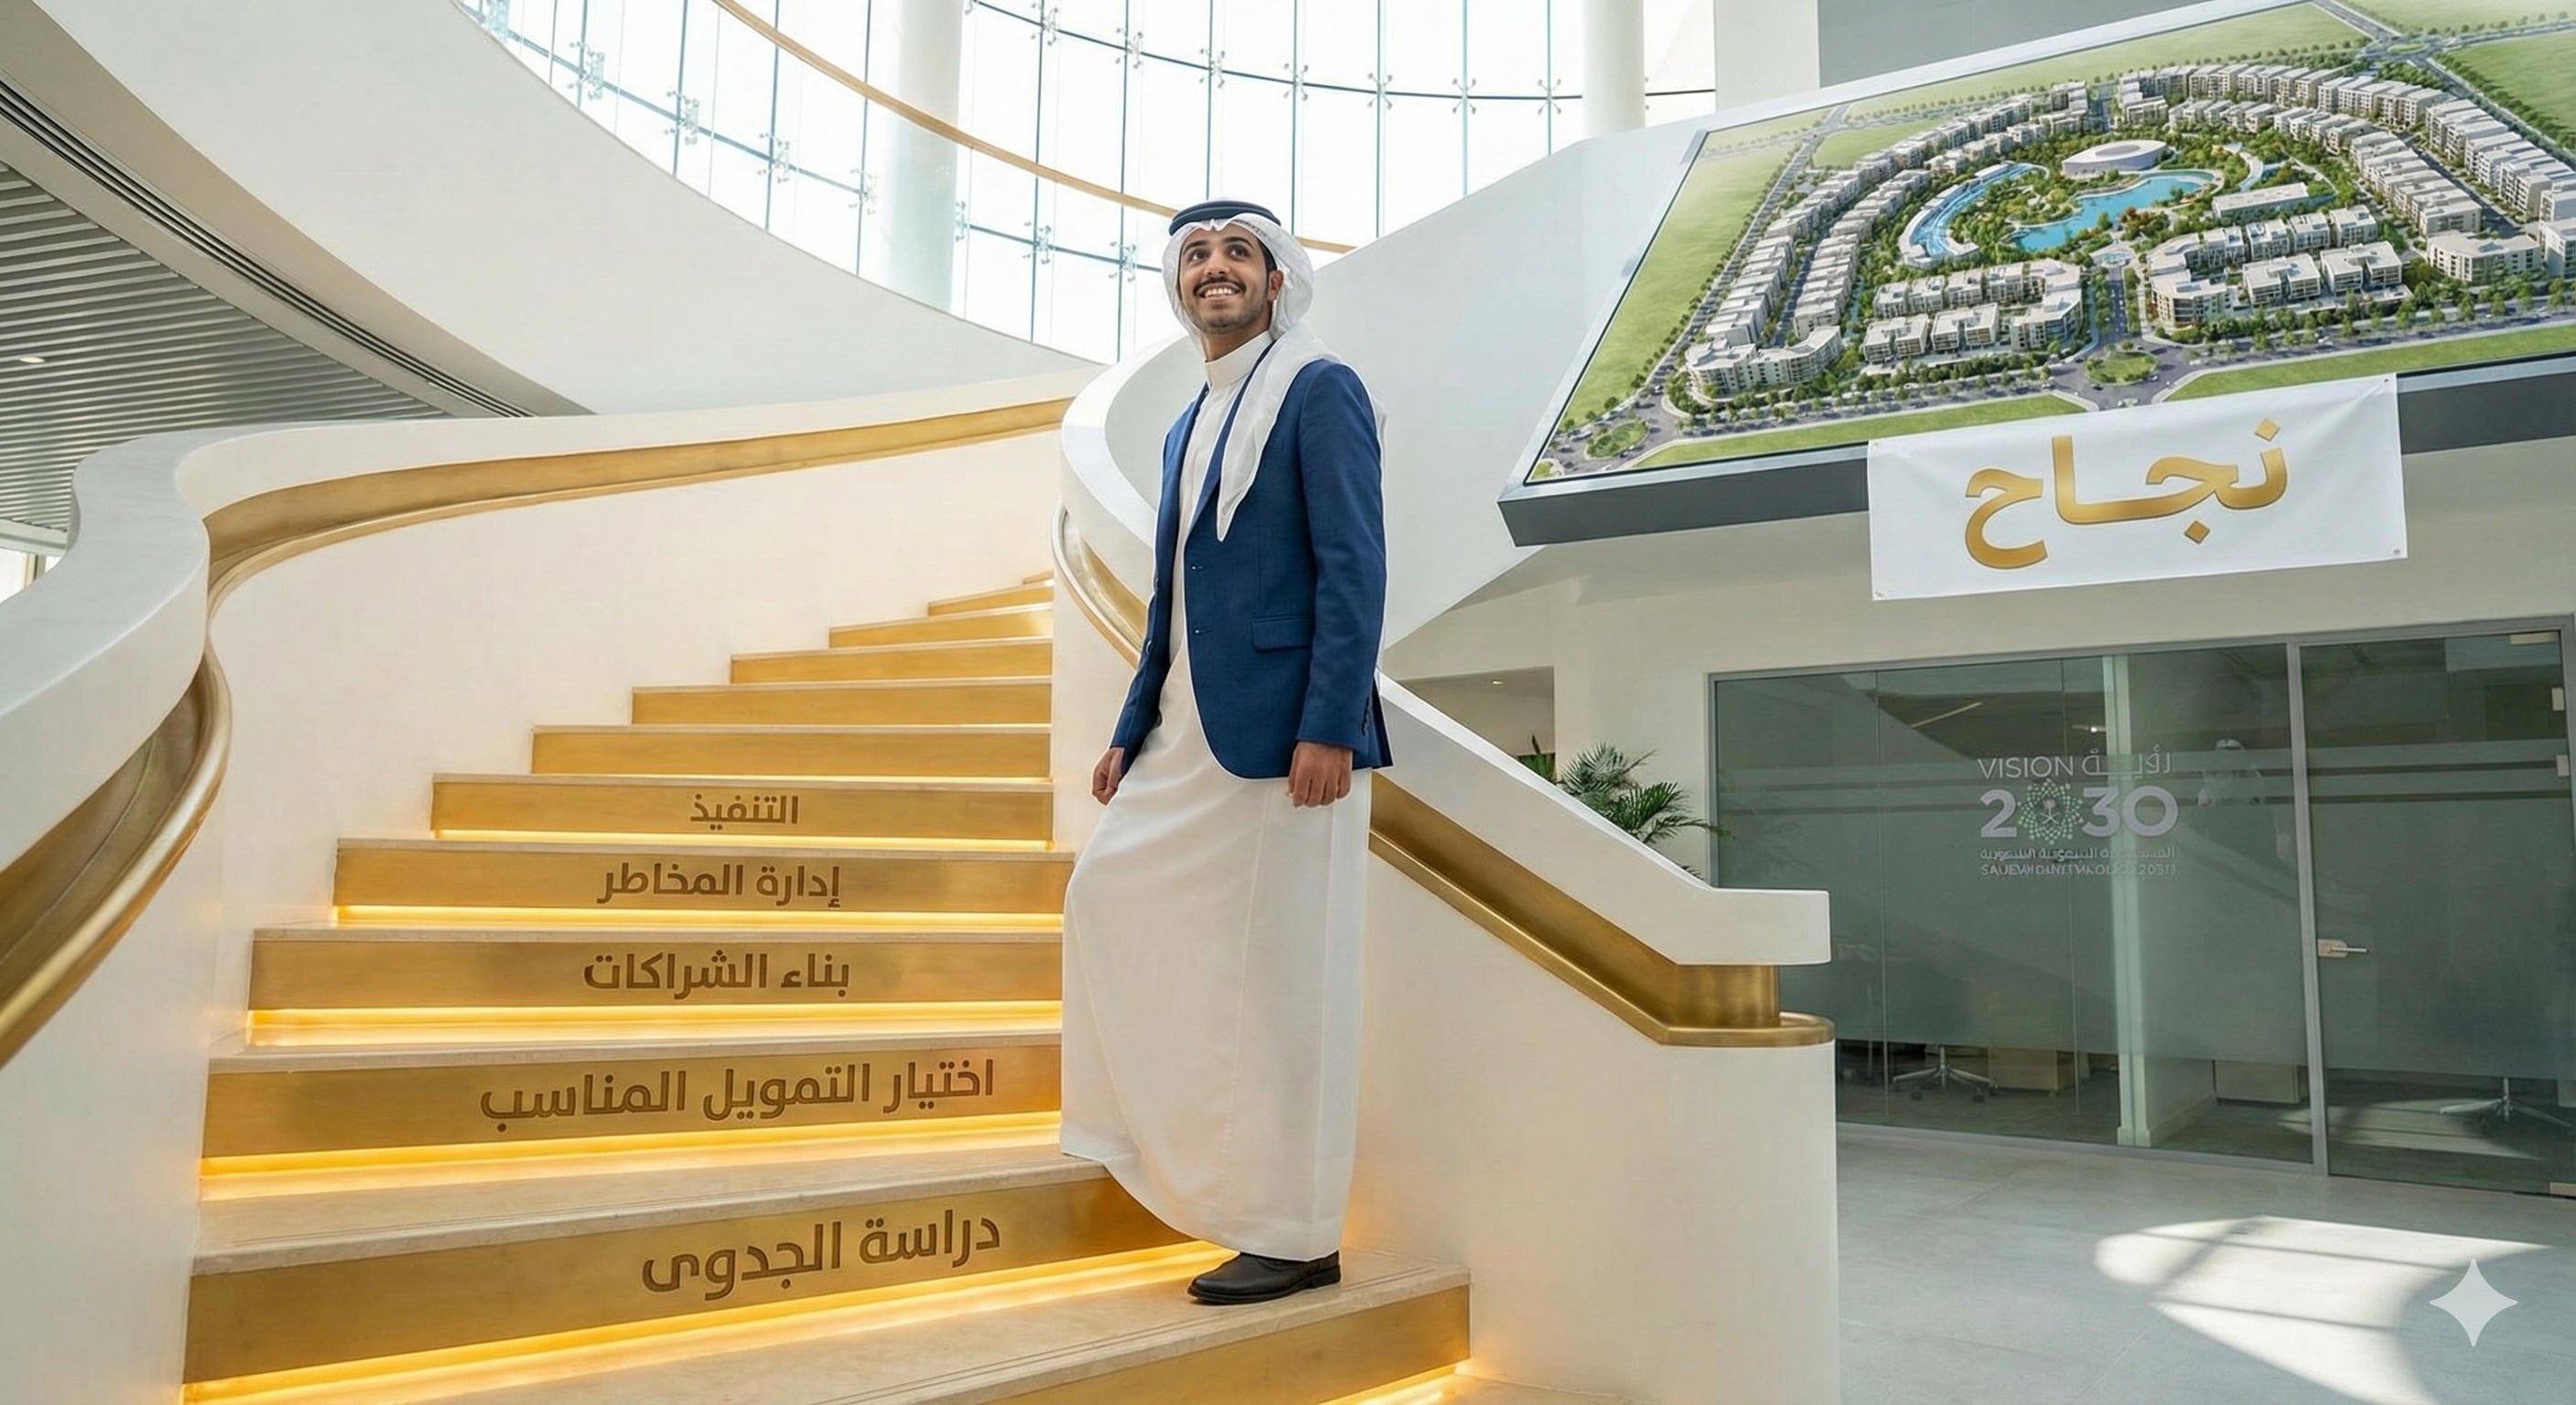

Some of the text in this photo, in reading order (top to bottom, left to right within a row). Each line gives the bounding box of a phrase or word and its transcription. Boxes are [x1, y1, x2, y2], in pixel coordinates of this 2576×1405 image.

[1964, 417, 2290, 571] نجاح
[1977, 755, 2075, 779] VISION
[690, 793, 799, 831] التنفيذ
[596, 862, 841, 908] إدارة المخاطر
[584, 949, 850, 1001] بناء الشراكات
[480, 1058, 993, 1133] اختيار التمويل المناسب
[641, 1208, 1000, 1302] دراسة الجدوى
